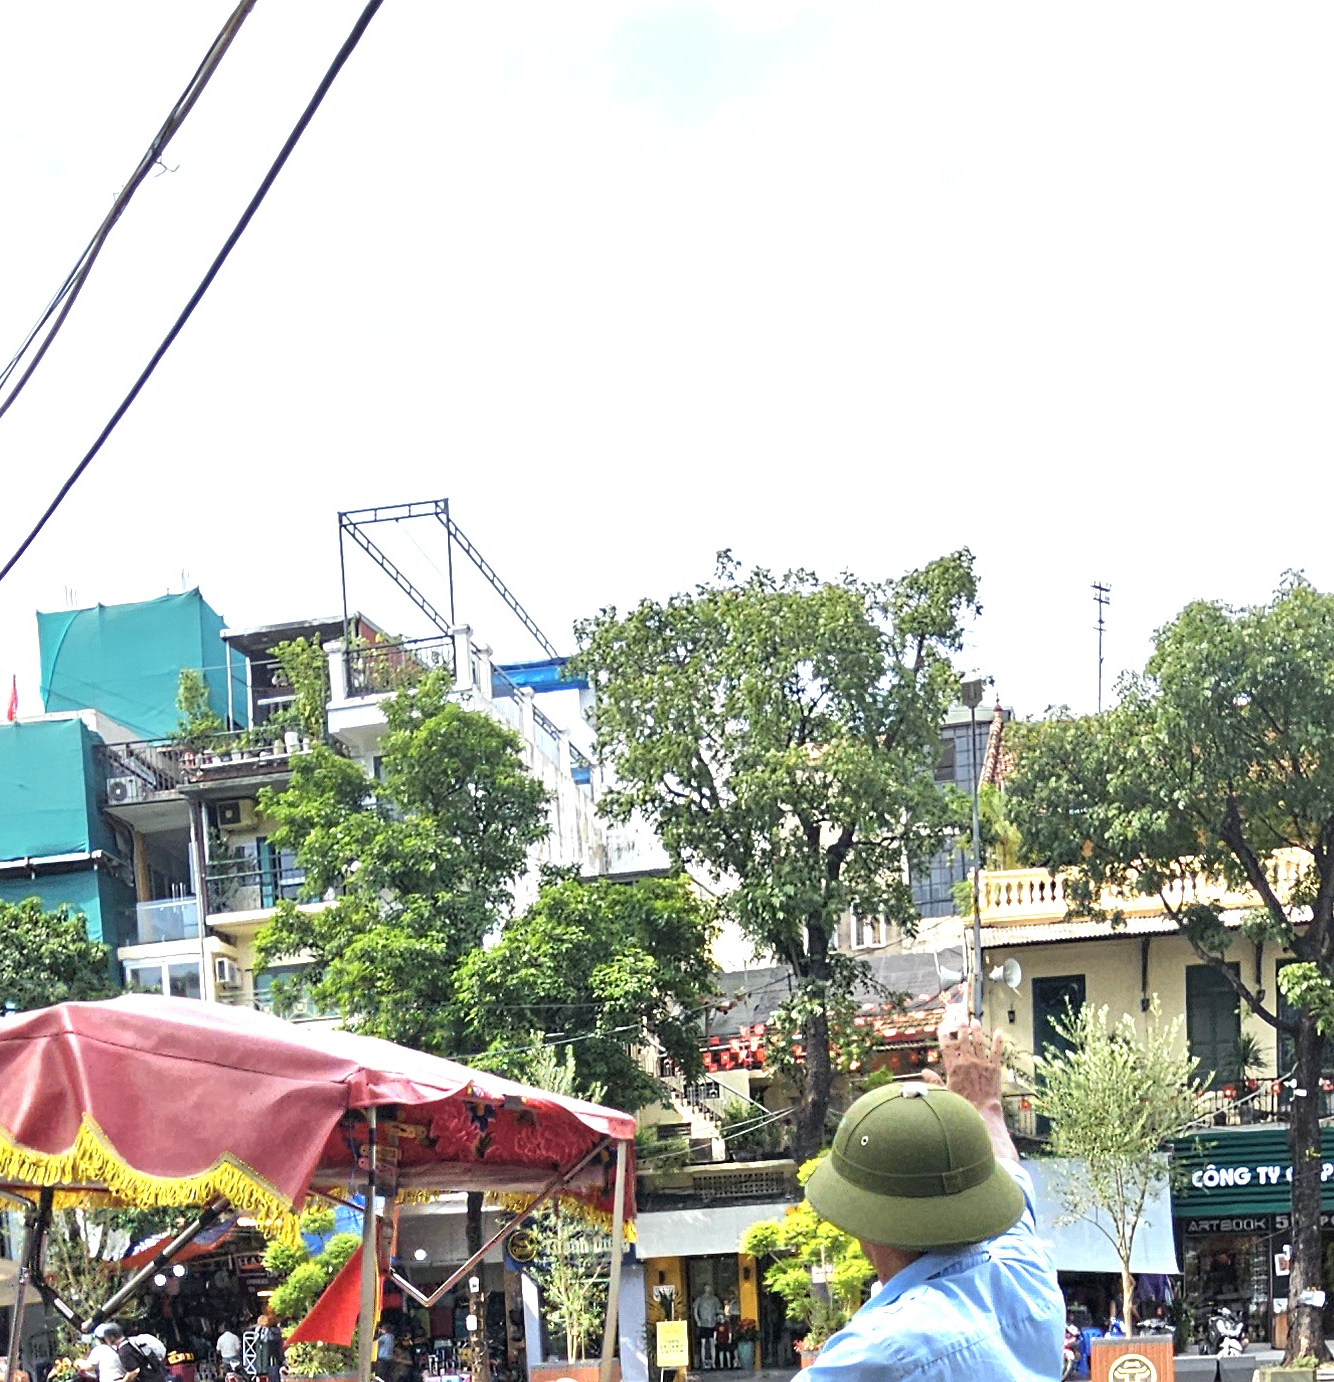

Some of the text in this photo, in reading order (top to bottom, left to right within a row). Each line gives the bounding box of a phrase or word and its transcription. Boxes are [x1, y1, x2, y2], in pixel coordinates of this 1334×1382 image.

[1192, 1163, 1251, 1188] CÔNG
[1257, 1165, 1280, 1184] TY
[1188, 1218, 1267, 1232] ARTBOOK
